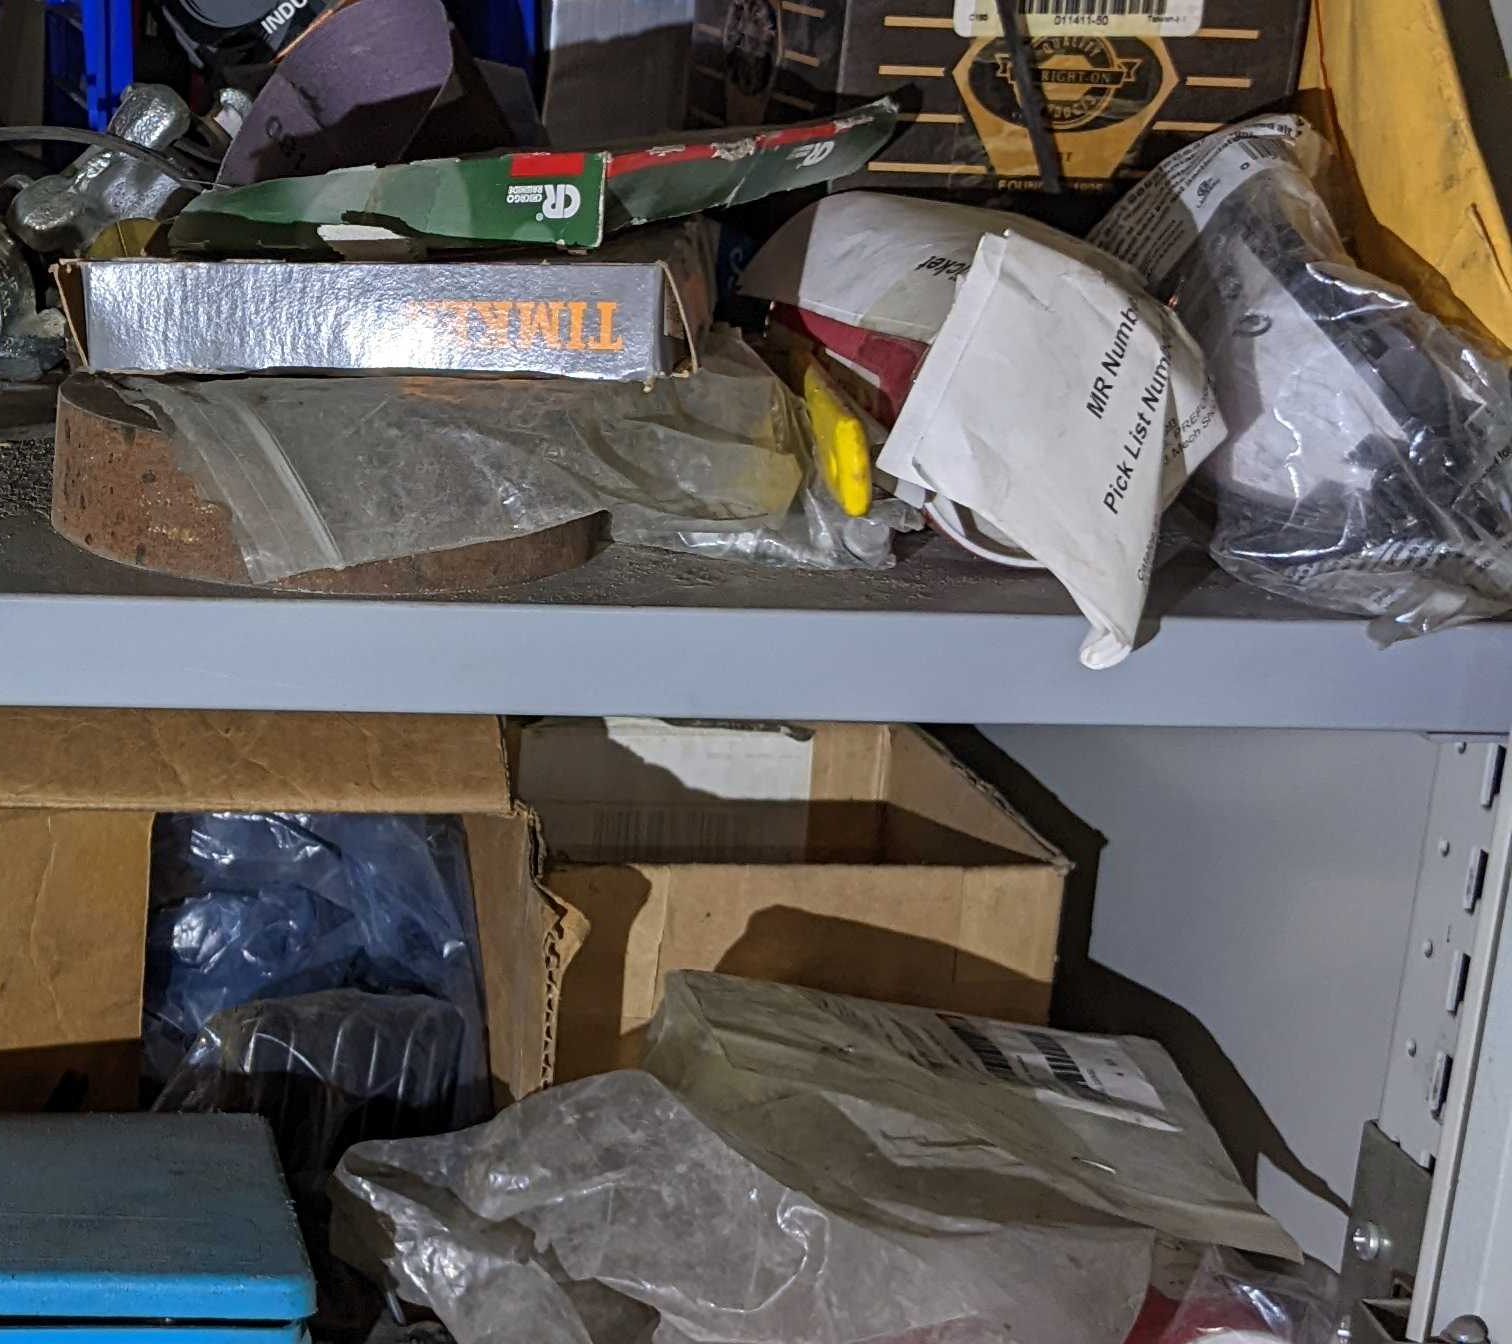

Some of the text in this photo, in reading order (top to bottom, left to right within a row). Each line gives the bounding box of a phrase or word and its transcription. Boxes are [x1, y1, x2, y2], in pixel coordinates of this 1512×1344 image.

[542, 184, 581, 219] CR
[1086, 376, 1113, 420] MR
[1103, 460, 1134, 515] Pick
[1124, 412, 1153, 460] List
